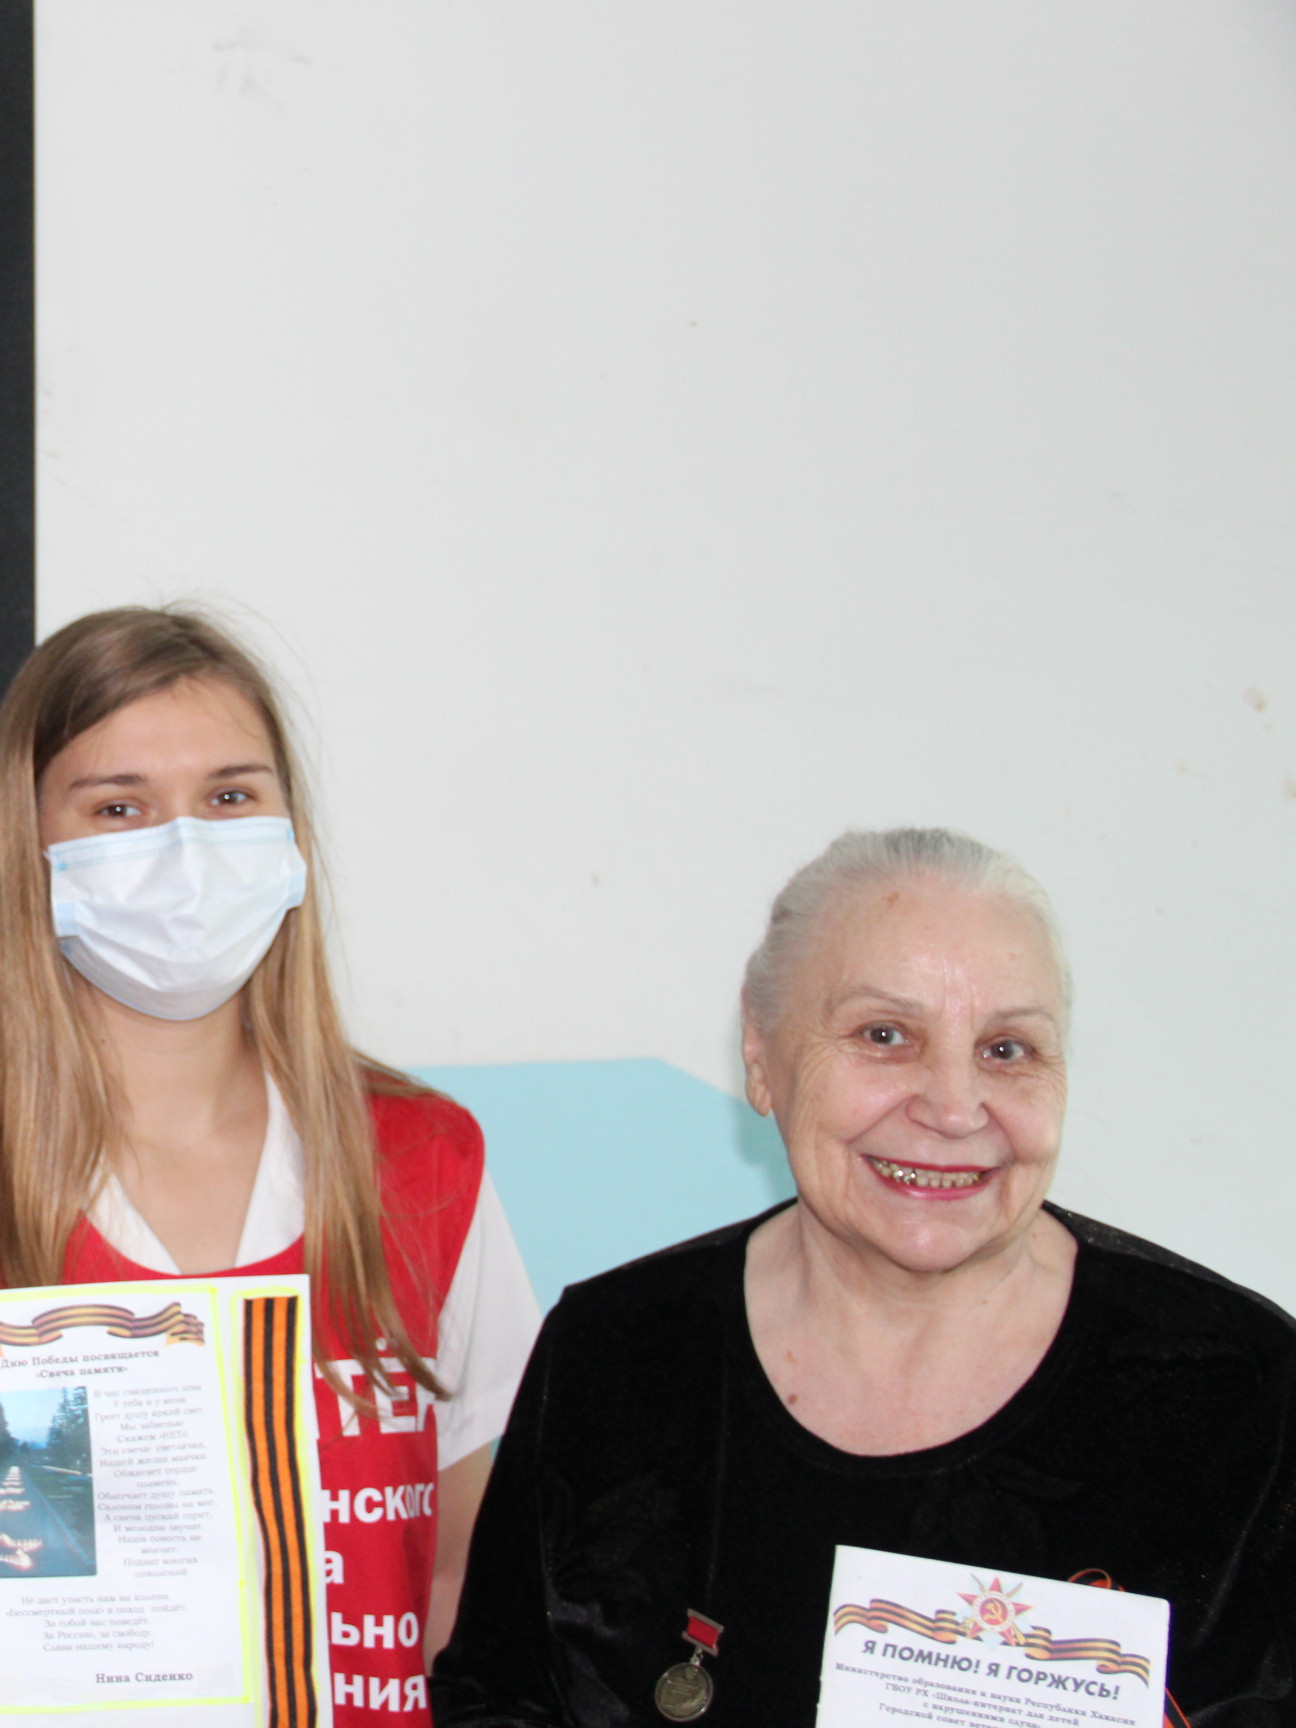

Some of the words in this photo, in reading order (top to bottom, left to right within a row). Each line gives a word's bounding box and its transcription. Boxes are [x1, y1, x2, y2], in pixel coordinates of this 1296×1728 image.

[0, 1357, 29, 1370] Дню
[32, 1353, 79, 1367] Победы
[82, 1349, 161, 1363] посвящается
[314, 1336, 438, 1438] ТЁР
[328, 1611, 420, 1650] ьно
[95, 1672, 131, 1684] Нина
[134, 1670, 194, 1684] Сиденко
[861, 1639, 877, 1656] Я
[881, 1643, 981, 1675] ПОМНЮ!
[985, 1662, 1001, 1678] Я
[1005, 1665, 1121, 1701] ГОРЖУСЬ!
[333, 1672, 427, 1713] ния
[835, 1661, 909, 1683] Министерство
[912, 1677, 977, 1696] образования
[980, 1690, 987, 1698] и
[990, 1692, 1022, 1705] науки
[1024, 1697, 1088, 1718] Республики
[1090, 1709, 1136, 1727] Хакасия
[886, 1681, 913, 1694] ГБОУ
[915, 1686, 930, 1698] РХ
[1026, 1710, 1045, 1720] для
[1048, 1713, 1080, 1727] детей
[922, 1701, 929, 1709] с
[932, 1702, 1006, 1724] нарушениями
[879, 1701, 934, 1721] Городской
[936, 1715, 967, 1728] совет
